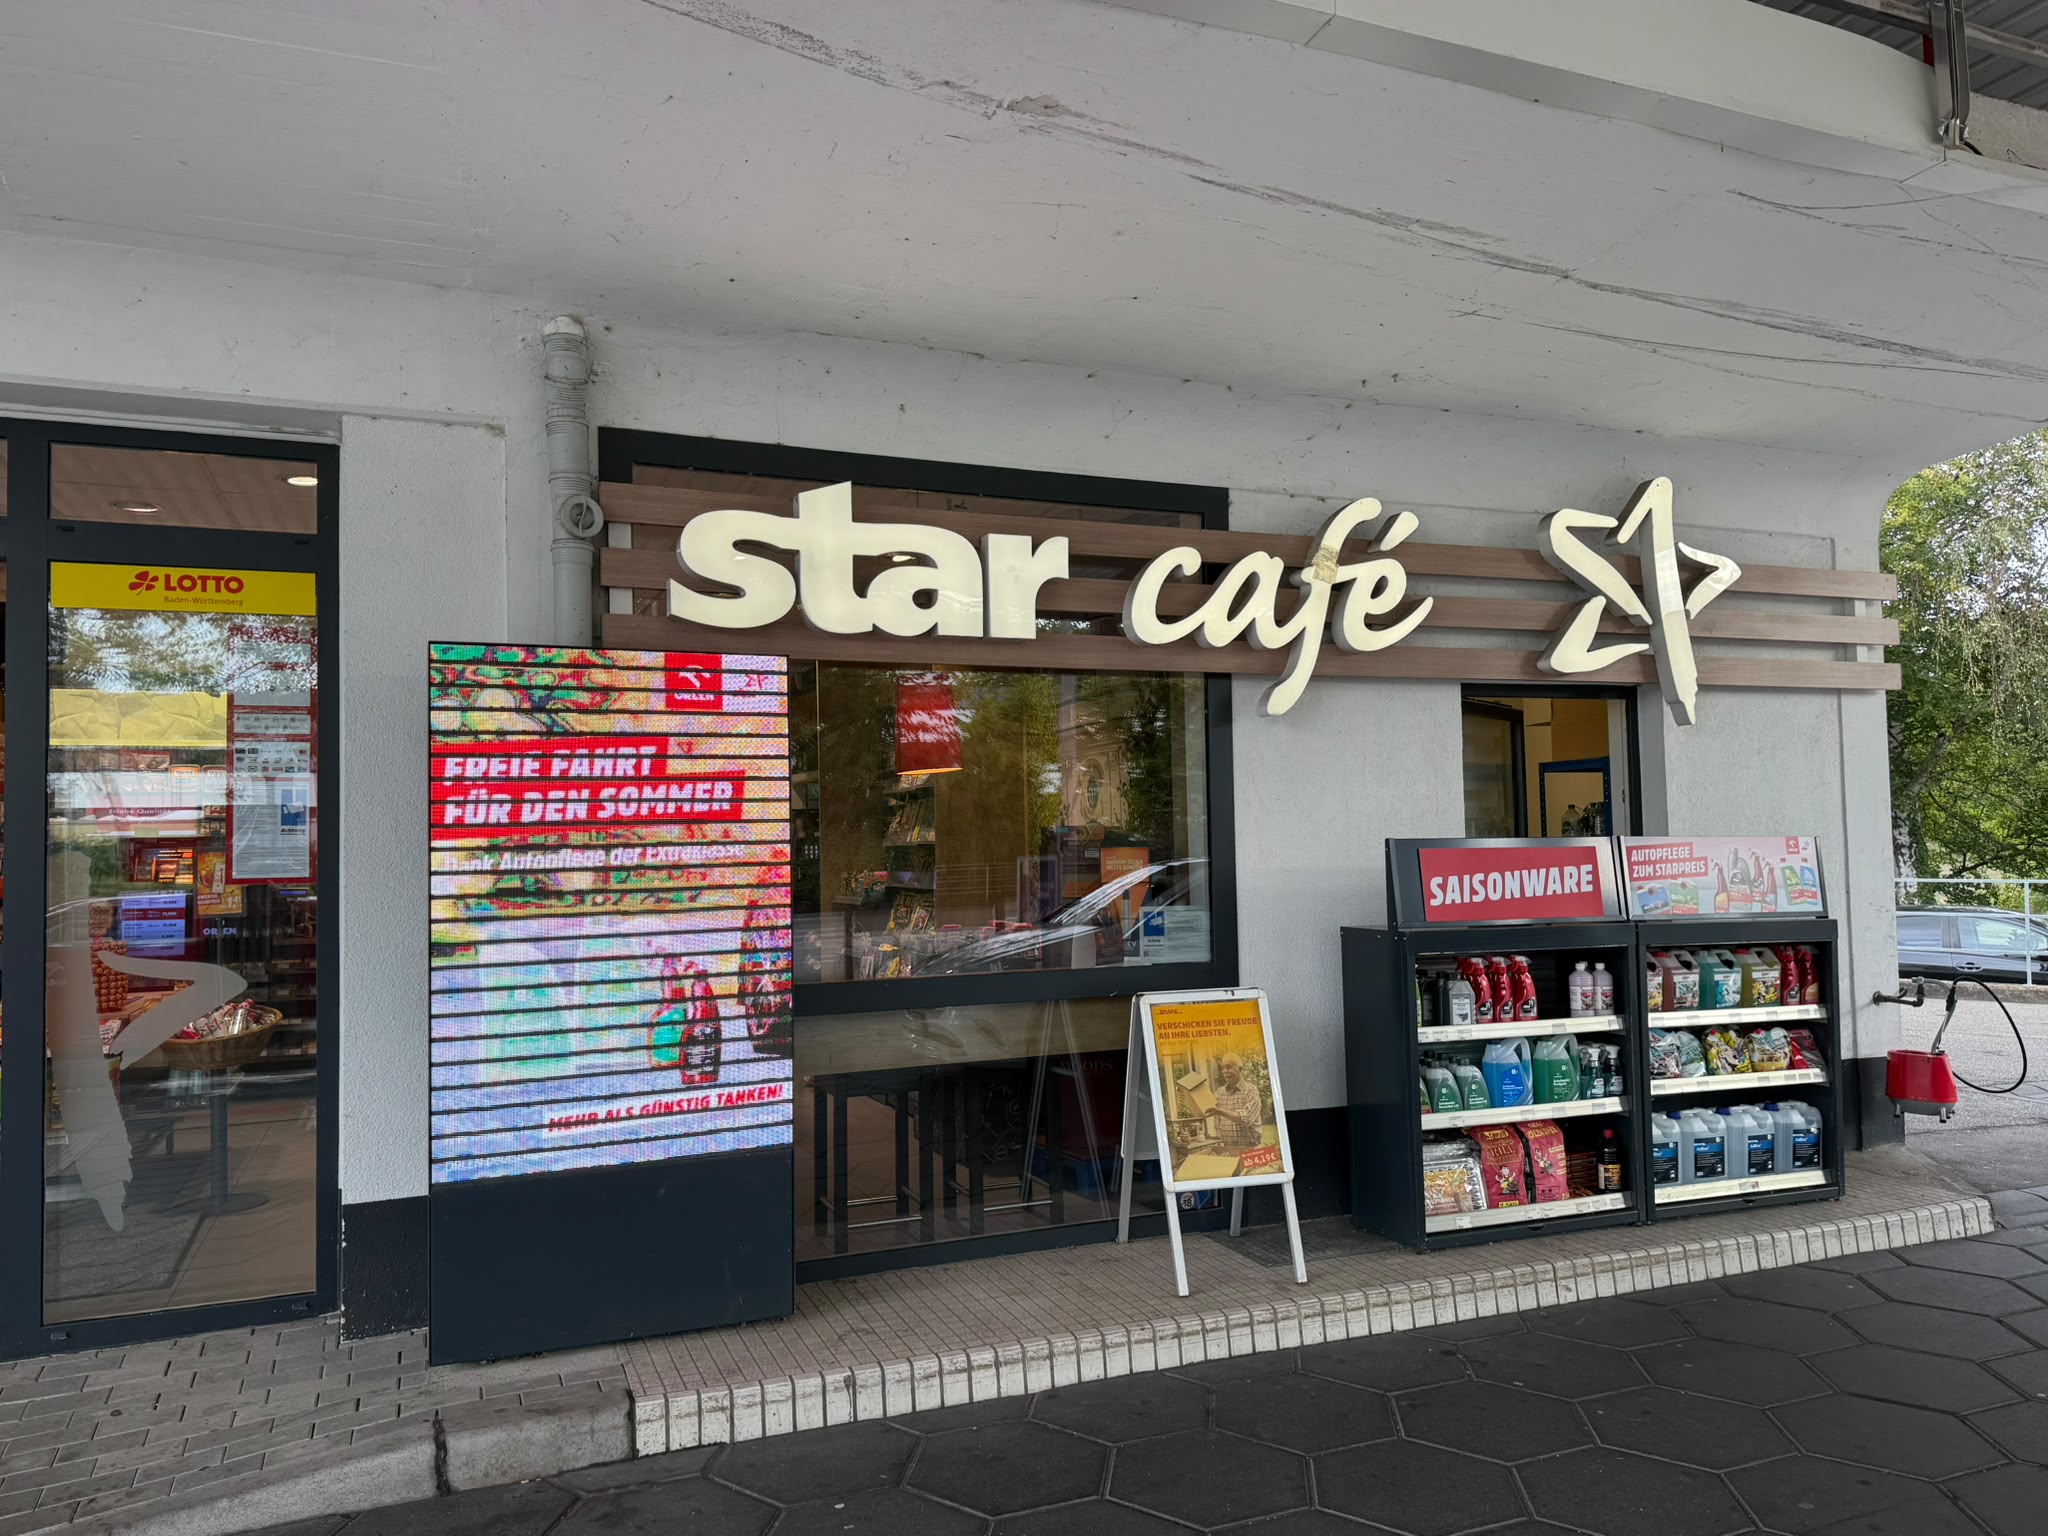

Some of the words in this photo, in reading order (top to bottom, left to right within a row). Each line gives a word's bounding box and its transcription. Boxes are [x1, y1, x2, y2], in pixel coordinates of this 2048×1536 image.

[164, 573, 245, 594] LOTTO
[163, 595, 244, 606] Baden-Württemberg
[667, 480, 1069, 640] star
[1122, 496, 1435, 716] café
[550, 745, 658, 778] FAHRT
[443, 788, 512, 824] FÜR
[521, 788, 590, 823] DEN
[597, 781, 734, 818] SOMMER
[1631, 846, 1691, 862] AUTOPFLEGE
[1632, 863, 1654, 878] ZUM
[1655, 861, 1706, 877] STARPREIS
[1430, 864, 1594, 906] SAISONWARE
[203, 927, 237, 936] OREN
[1157, 1020, 1212, 1030] VERSCHICKEN
[1213, 1019, 1225, 1027] SIE
[1227, 1017, 1258, 1026] FREUDE
[1158, 1031, 1170, 1040] AN
[1171, 1030, 1190, 1039] IHRE
[1191, 1028, 1232, 1038] LIEBSTEN.
[639, 1095, 712, 1116] GÜNSTIG
[716, 1084, 784, 1107] TANKEN!
[1243, 1157, 1254, 1167] ab
